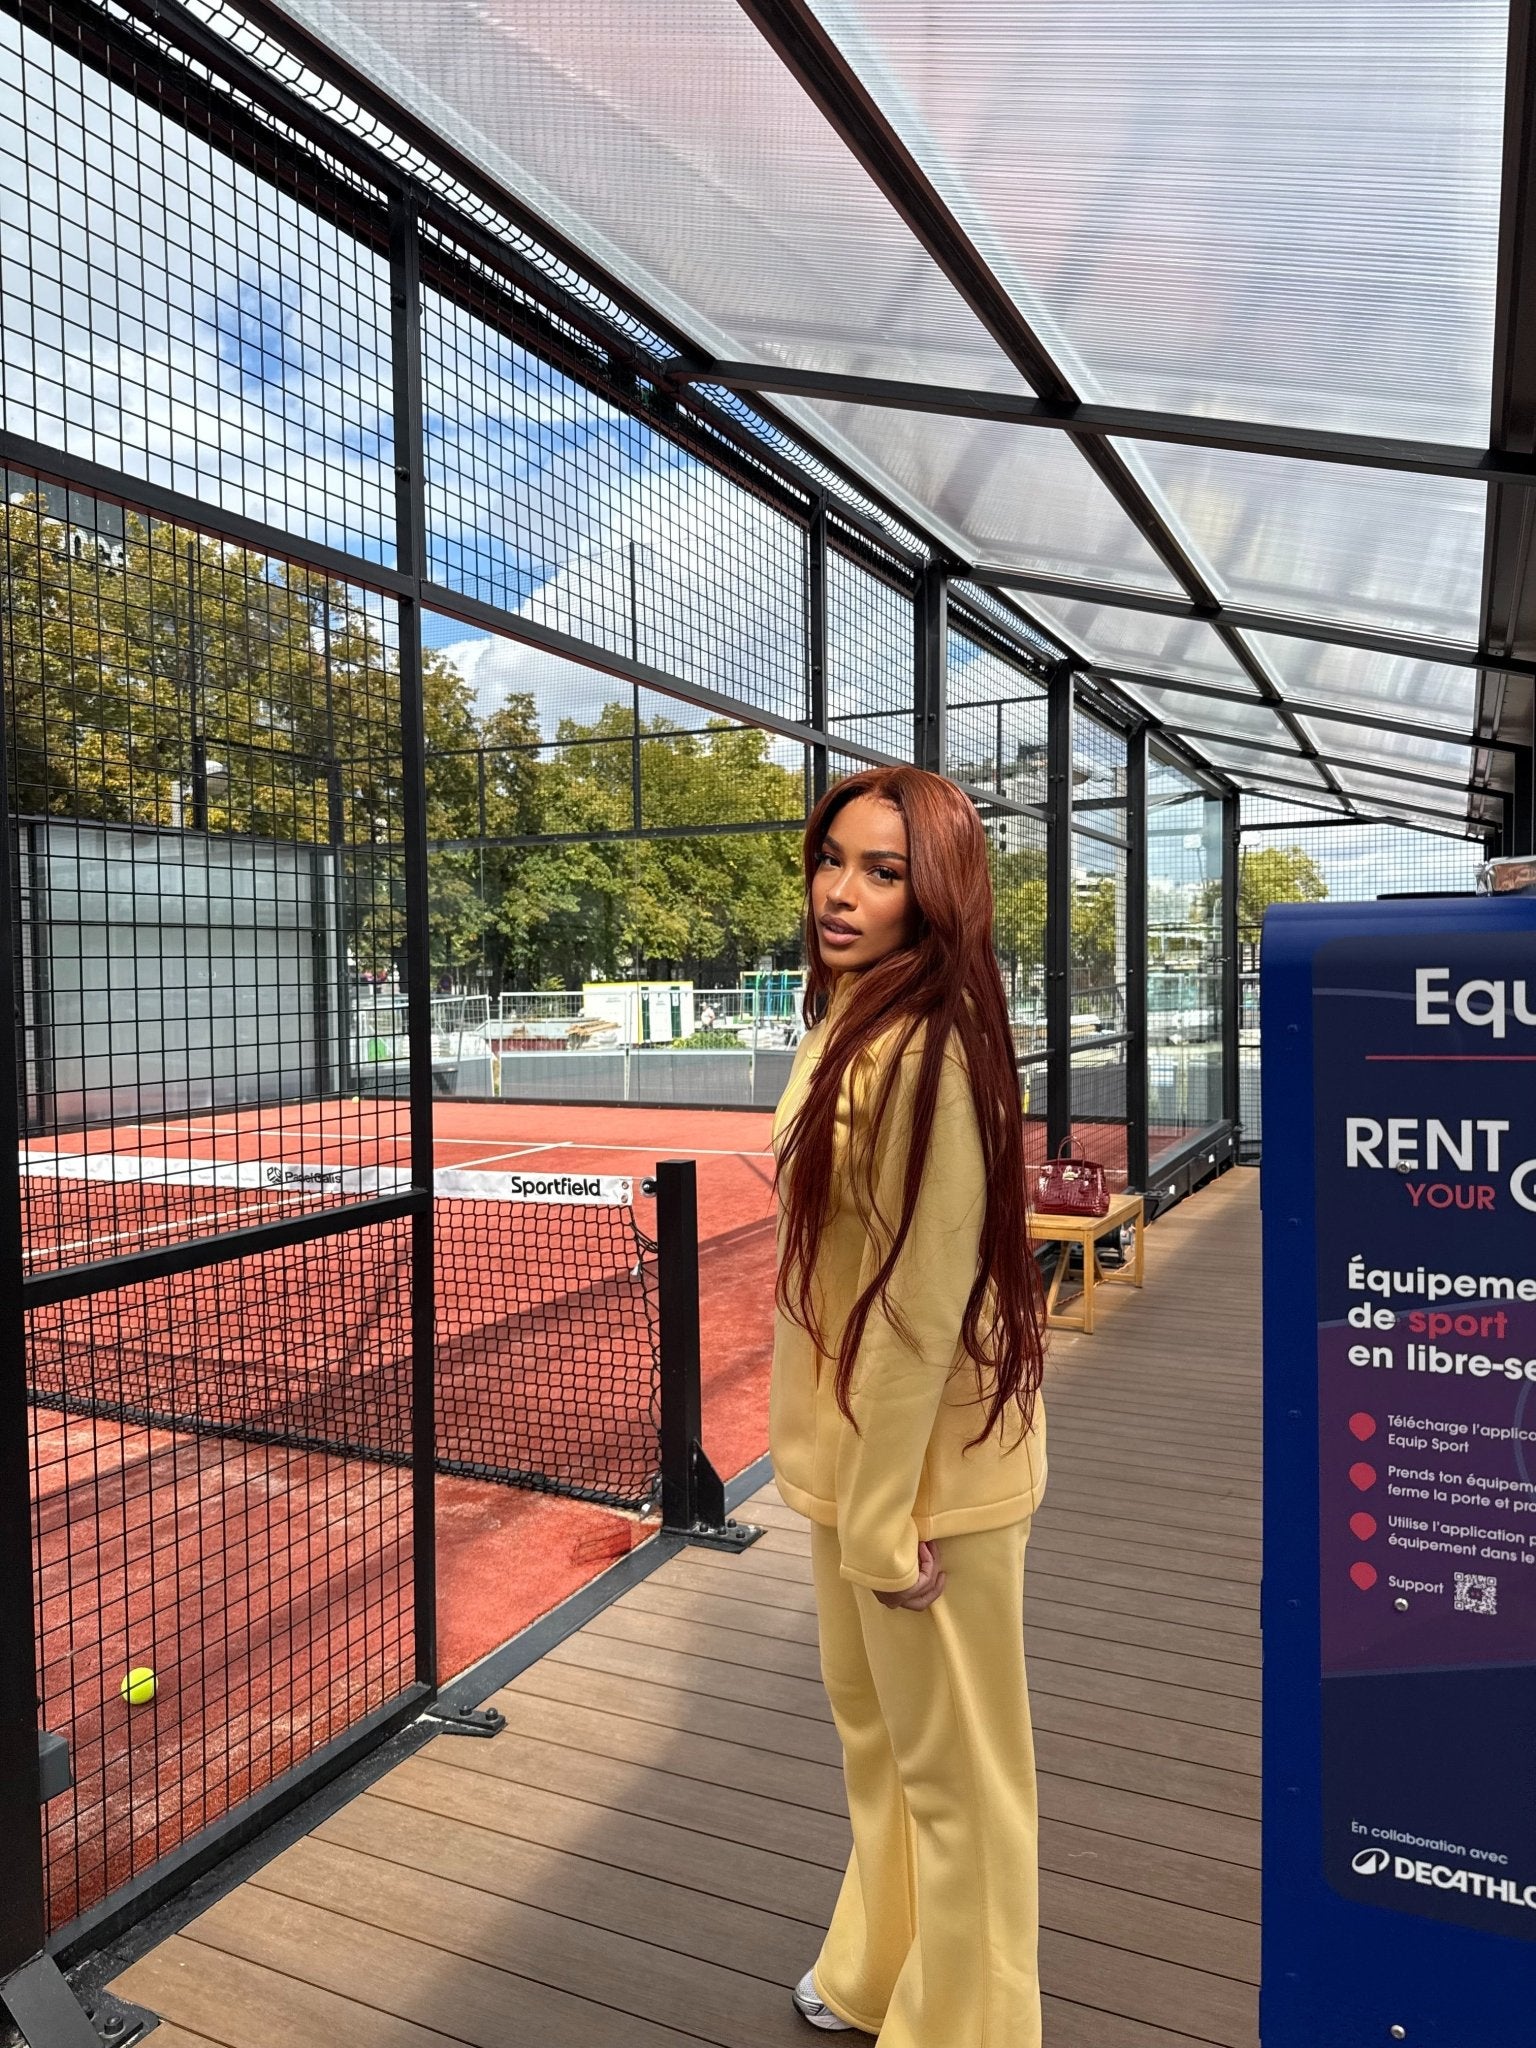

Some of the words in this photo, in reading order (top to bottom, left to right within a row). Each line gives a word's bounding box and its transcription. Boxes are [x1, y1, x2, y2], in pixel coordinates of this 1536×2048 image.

[1346, 1117, 1510, 1172] RENT
[511, 1176, 601, 1197] Sportfield
[1406, 1183, 1496, 1210] YOUR
[1347, 1302, 1396, 1331] de
[1408, 1311, 1508, 1340] sport
[1348, 1345, 1394, 1369] en
[1387, 1415, 1469, 1436] Télécharge
[1388, 1433, 1428, 1450] Equip
[1431, 1437, 1470, 1453] Sport
[1388, 1465, 1435, 1482] Prends
[1438, 1471, 1463, 1484] ton
[1466, 1473, 1536, 1494] équipem
[1387, 1483, 1430, 1500] ferme
[1433, 1489, 1448, 1502] la
[1451, 1492, 1491, 1507] porte
[1494, 1497, 1510, 1509] et
[1387, 1515, 1429, 1531] Utilise
[1432, 1521, 1525, 1544] l'application
[1387, 1533, 1477, 1556] équipement
[1480, 1546, 1518, 1562] dans
[1521, 1550, 1536, 1565] le
[1388, 1575, 1445, 1594] Support
[1351, 1821, 1368, 1835] En
[1371, 1829, 1467, 1856] collaboration
[1469, 1848, 1509, 1865] avec
